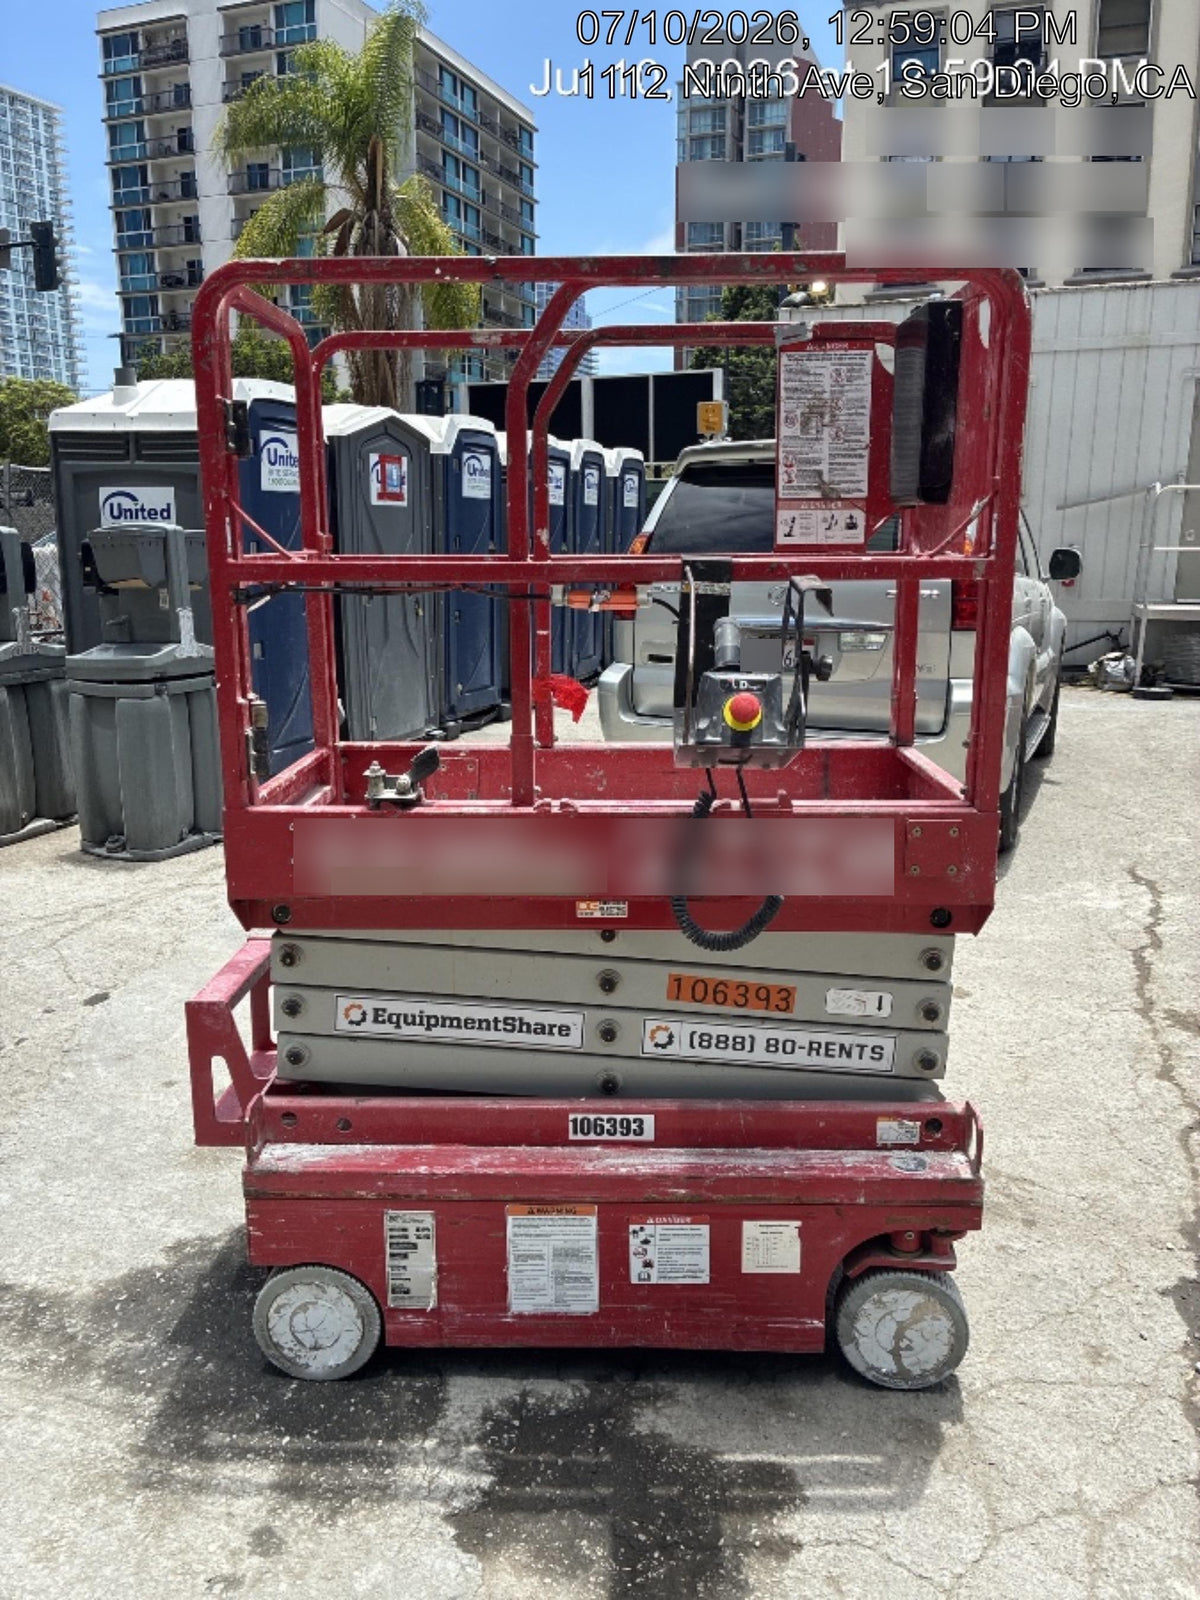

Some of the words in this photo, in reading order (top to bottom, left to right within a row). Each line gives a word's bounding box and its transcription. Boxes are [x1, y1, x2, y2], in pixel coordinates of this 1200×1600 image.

[267, 447, 299, 468] Unite
[109, 502, 172, 521] United
[671, 975, 793, 1013] 106393
[371, 1007, 571, 1038] EquipmentShare
[688, 1029, 756, 1056] (888)
[764, 1038, 885, 1064] 80-RENTS
[569, 1115, 645, 1138] 106393
